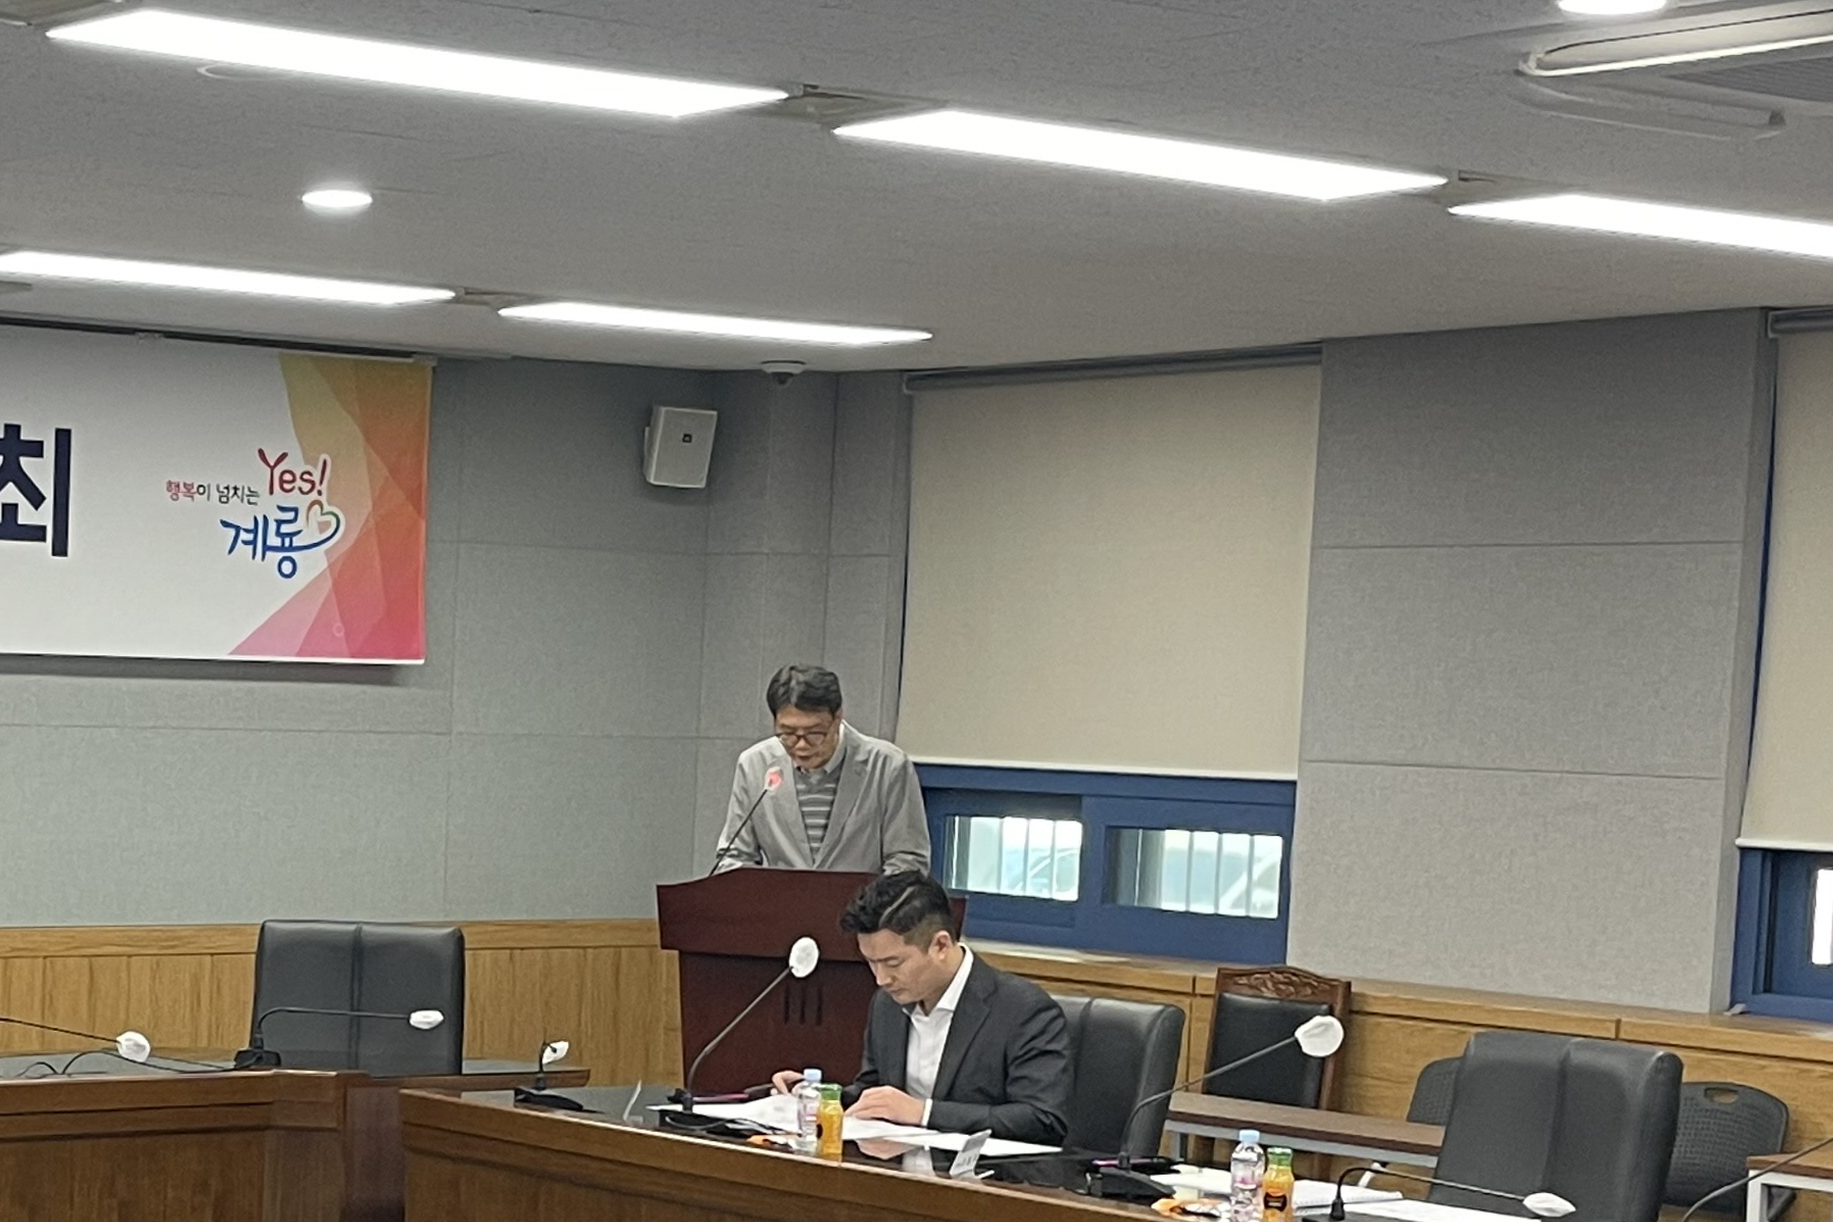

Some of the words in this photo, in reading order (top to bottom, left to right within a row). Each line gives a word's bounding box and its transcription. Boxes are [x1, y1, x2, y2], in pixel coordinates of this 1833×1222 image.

[166, 479, 211, 501] 행복이
[217, 483, 260, 506] 넘치는
[257, 448, 328, 496] Yes!
[220, 503, 313, 579] 계룡
